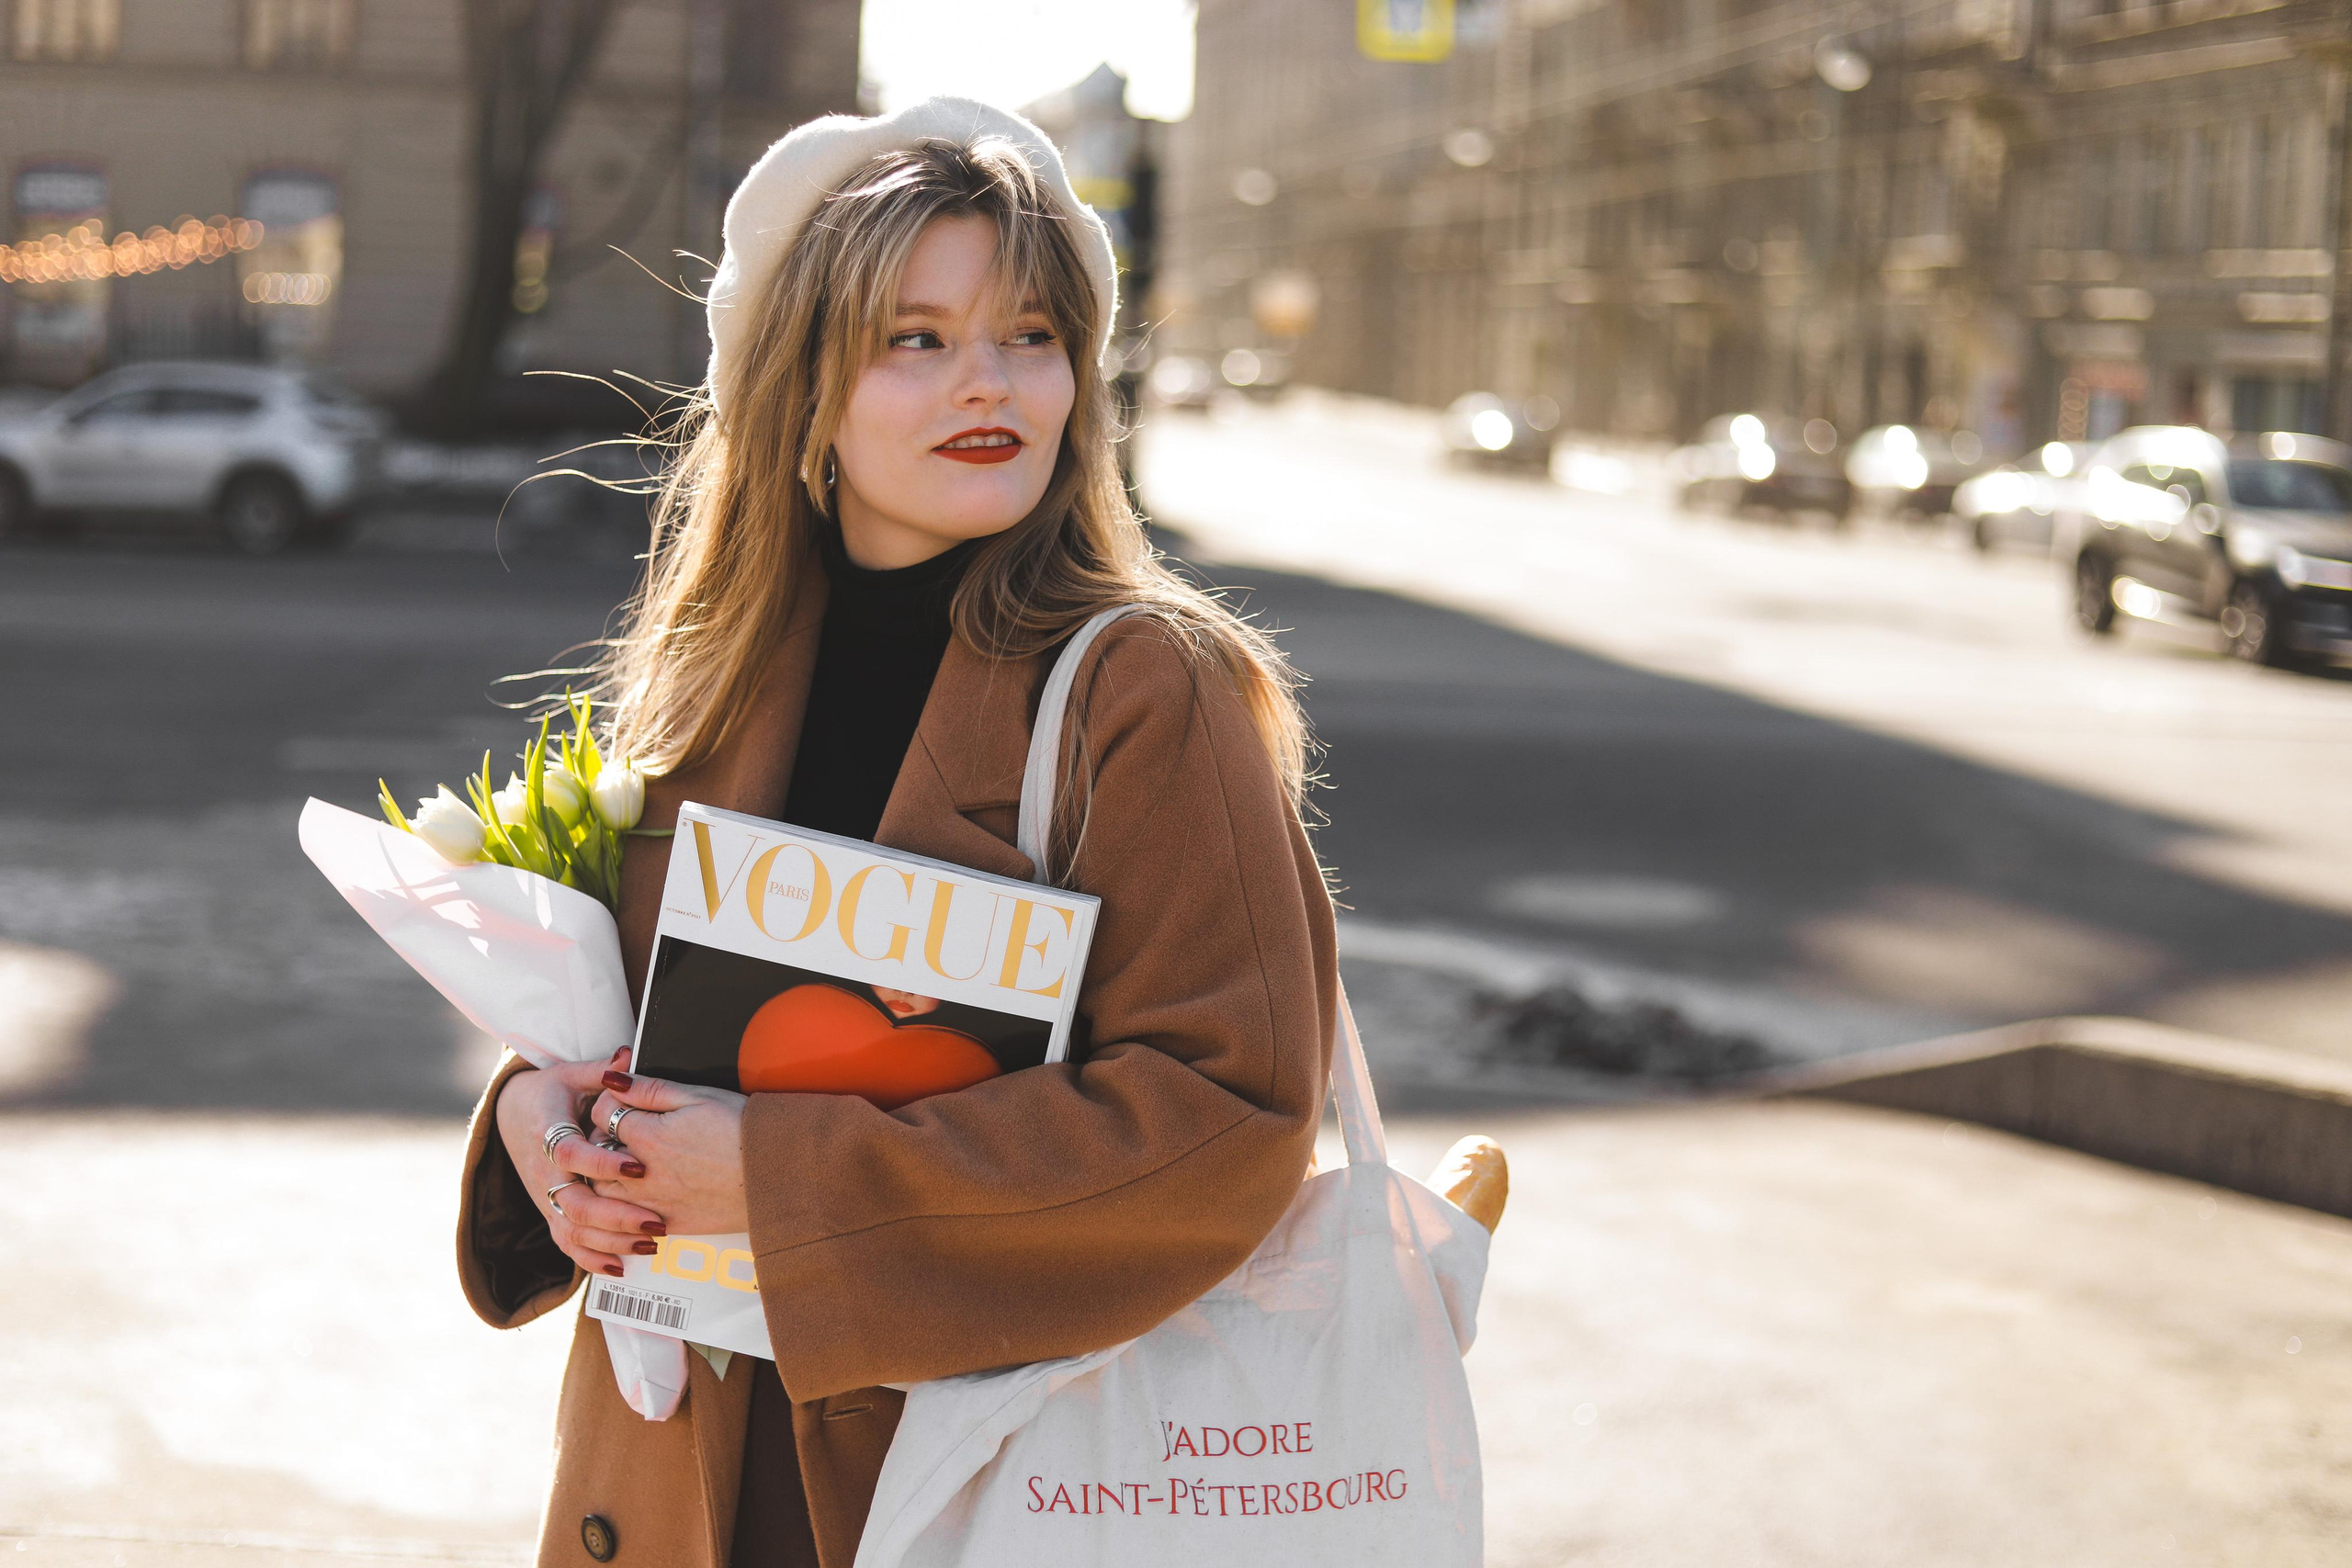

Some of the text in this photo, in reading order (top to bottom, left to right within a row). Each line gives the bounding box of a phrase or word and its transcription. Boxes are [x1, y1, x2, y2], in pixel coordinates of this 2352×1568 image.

[683, 817, 1075, 998] VOGUE
[768, 880, 810, 901] PARIS
[650, 1235, 758, 1293] 100
[1160, 1419, 1314, 1462] J'ADORE
[1027, 1469, 1408, 1517] SAINT-PÉTERSBOURG
